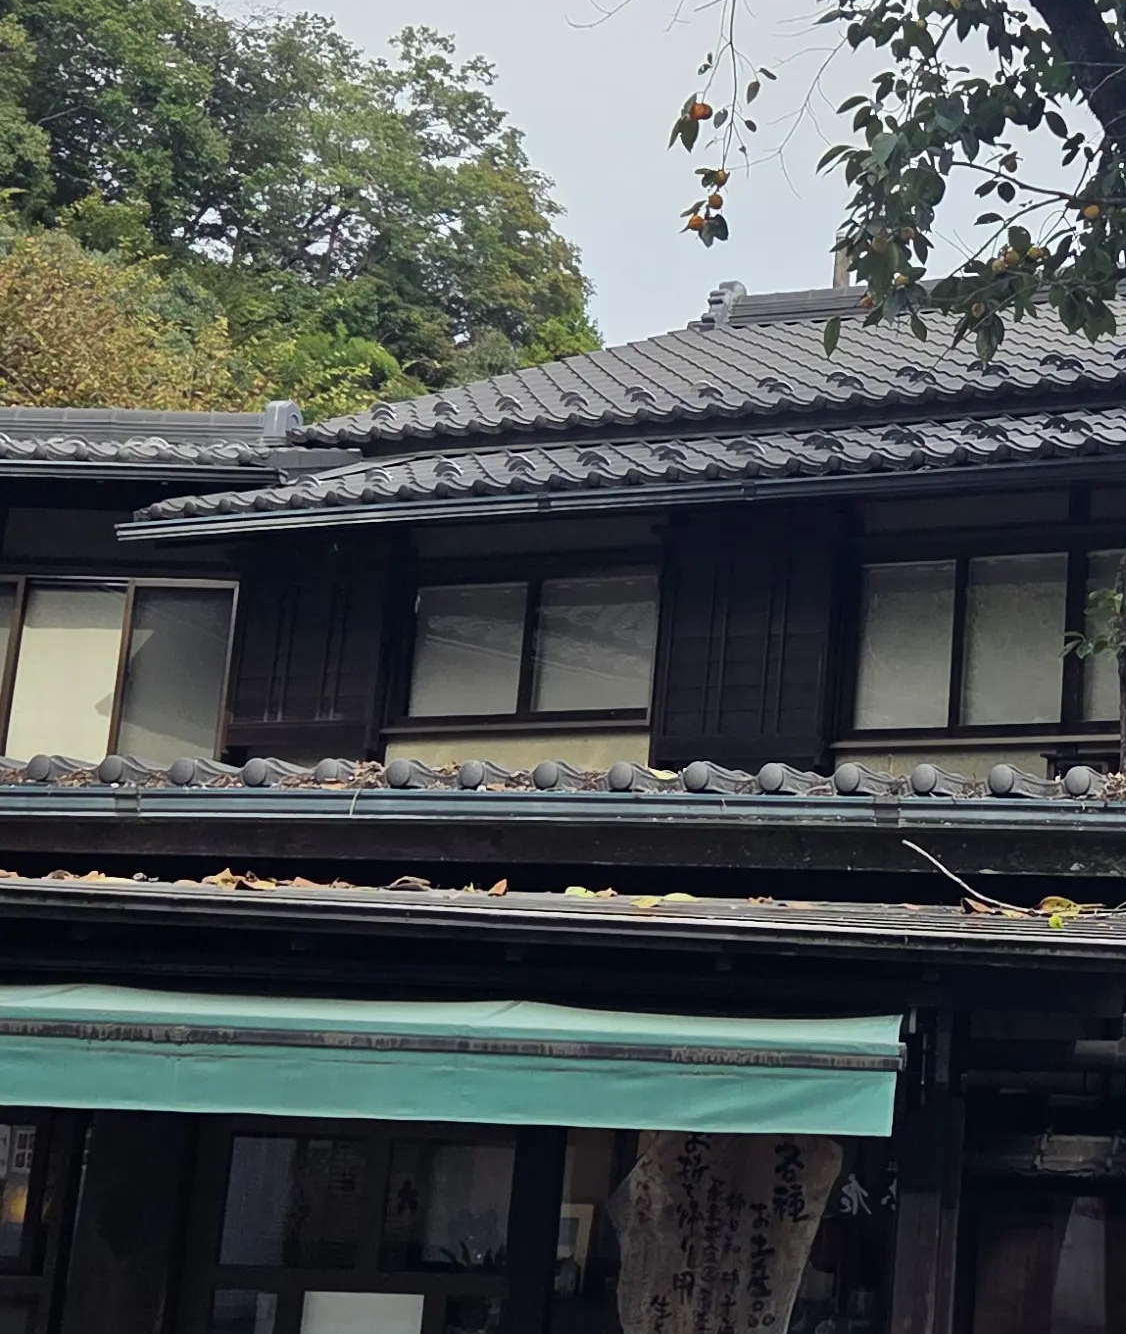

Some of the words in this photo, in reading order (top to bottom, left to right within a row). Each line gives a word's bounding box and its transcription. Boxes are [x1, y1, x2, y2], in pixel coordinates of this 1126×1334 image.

[772, 1141, 809, 1223] 各種
[746, 1202, 776, 1329] お土産品
